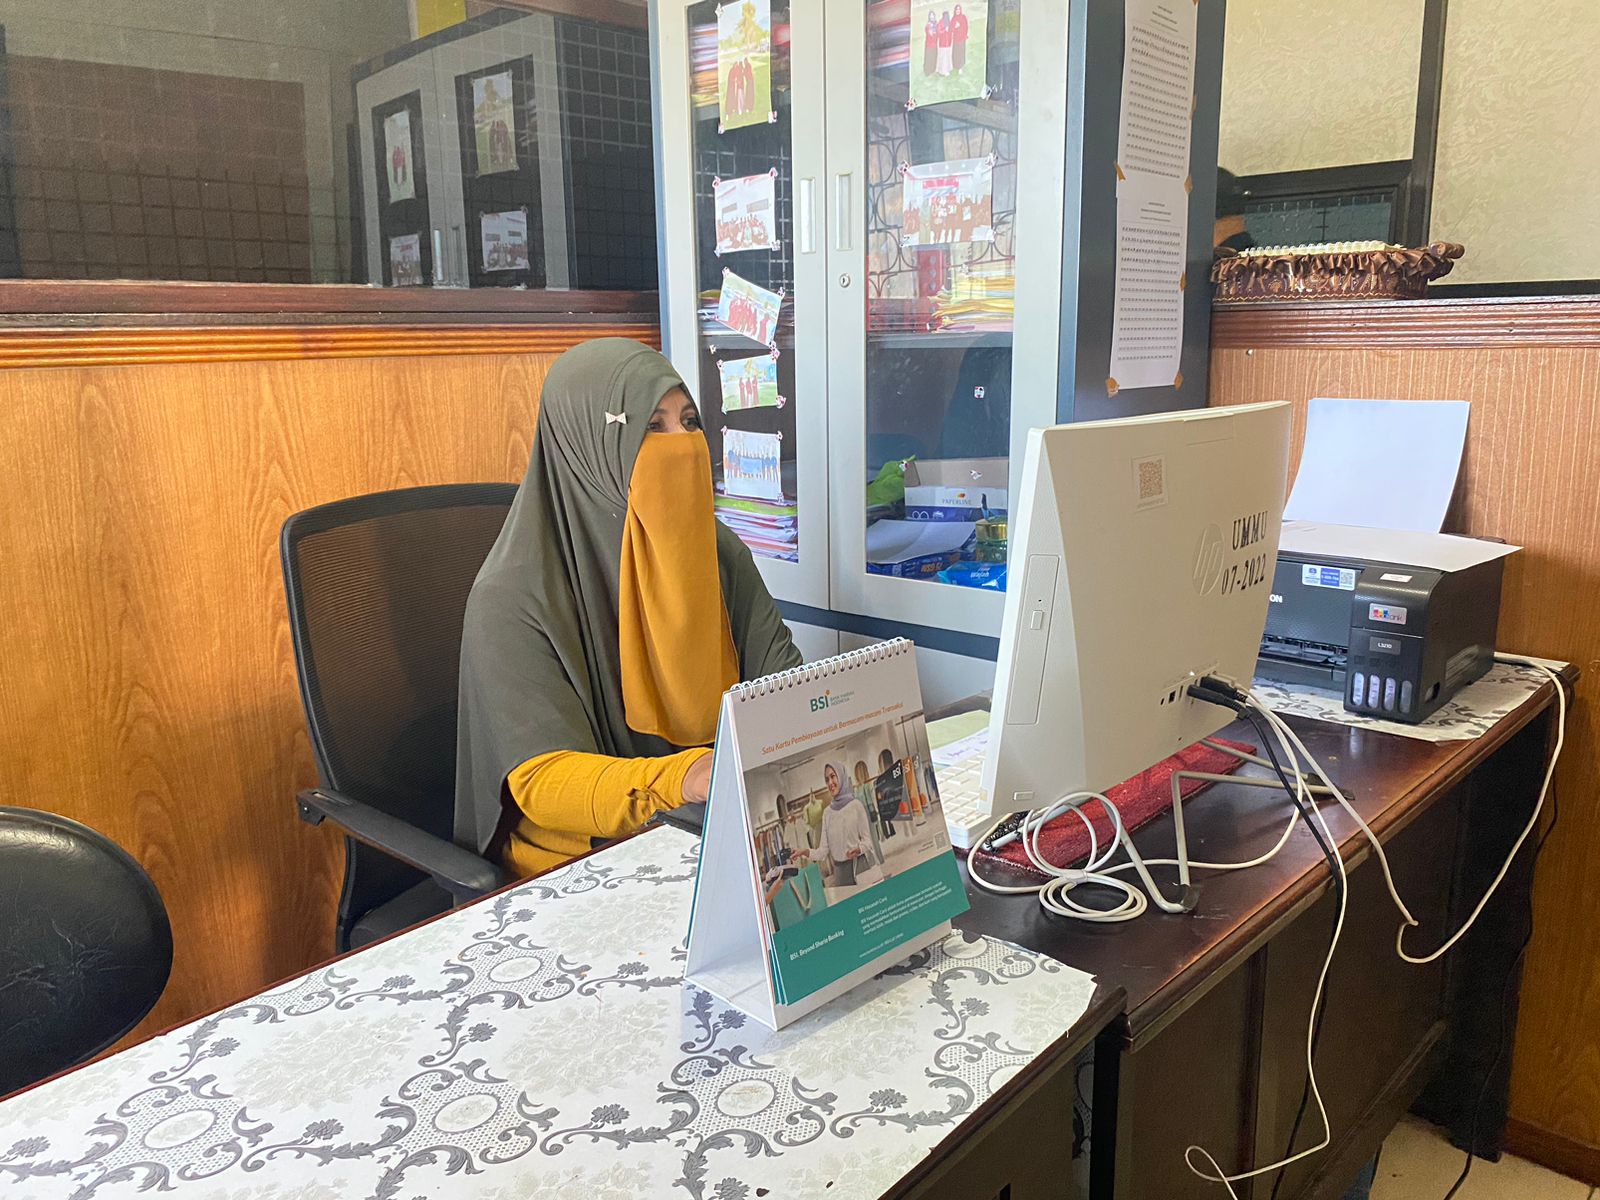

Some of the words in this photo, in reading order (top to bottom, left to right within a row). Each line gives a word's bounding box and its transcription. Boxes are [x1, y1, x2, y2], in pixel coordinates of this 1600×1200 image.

[1231, 511, 1268, 550] UMMU
[1221, 553, 1266, 595] 07-2022
[1269, 594, 1283, 603] ON
[810, 691, 829, 712] BSI
[761, 745, 775, 756] Satu
[775, 740, 791, 751] Kartu
